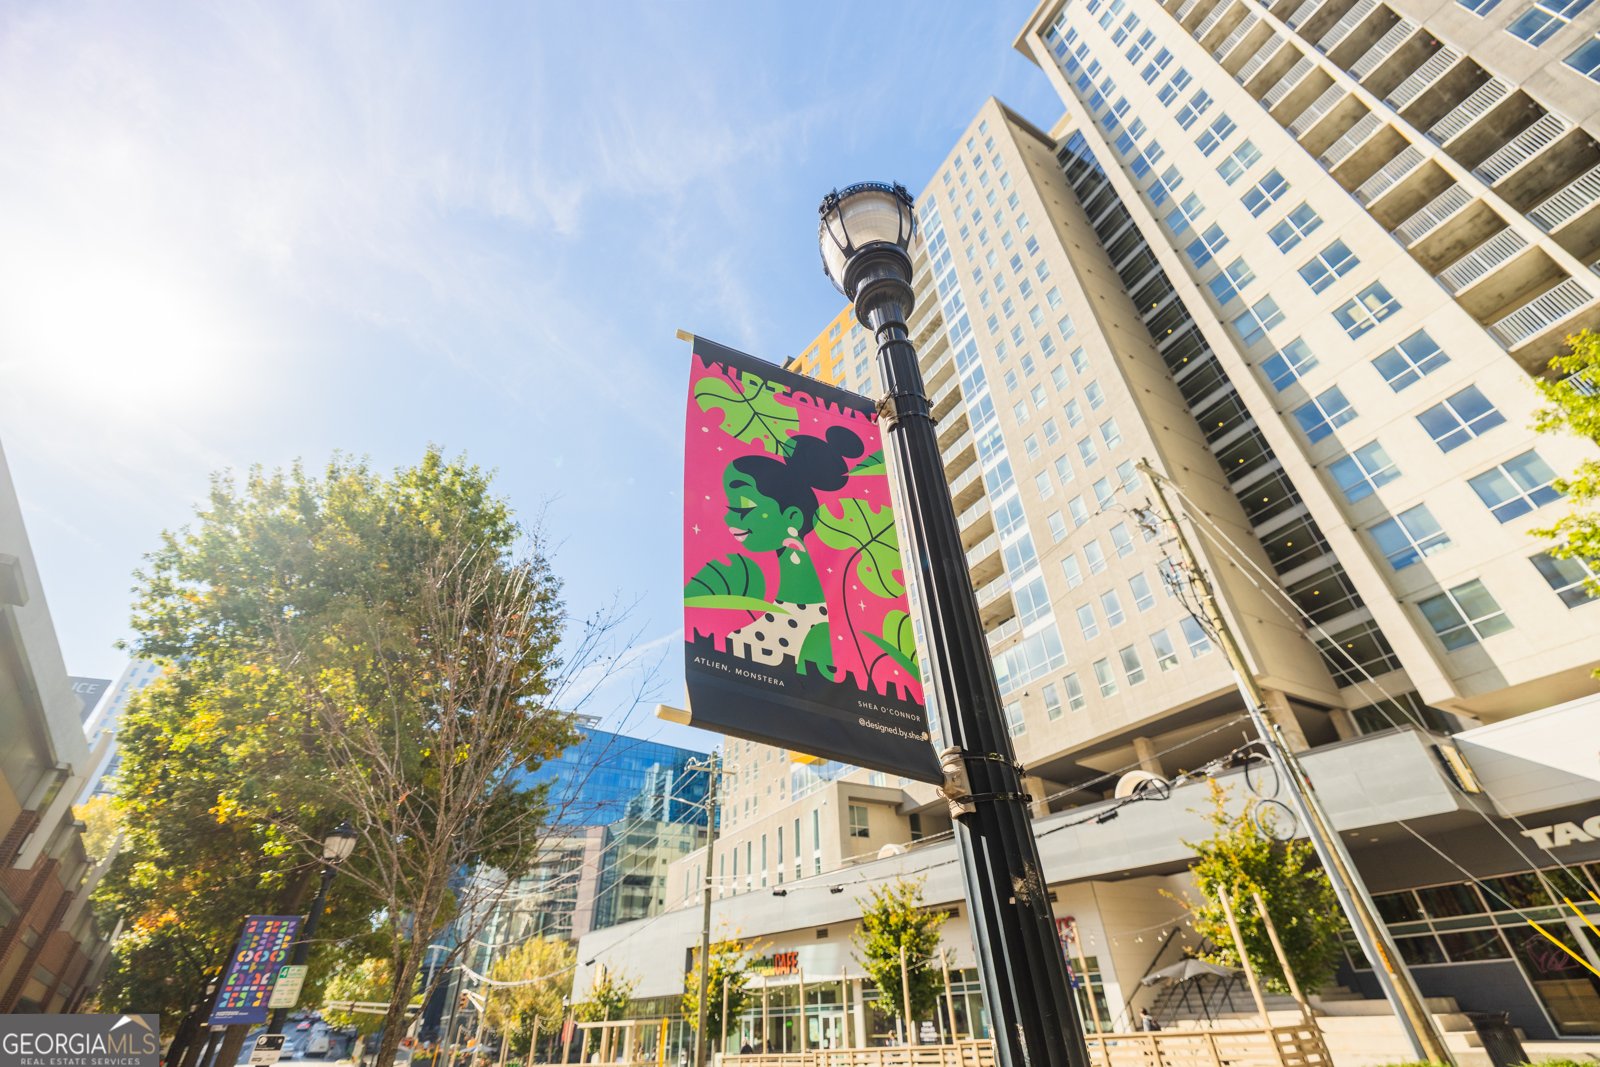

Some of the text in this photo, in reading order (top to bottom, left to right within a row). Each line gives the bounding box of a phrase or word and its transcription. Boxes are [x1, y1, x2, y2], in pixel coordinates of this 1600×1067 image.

[735, 668, 785, 687] MONSTERA
[857, 700, 921, 722] SHEA O'CONNOR
